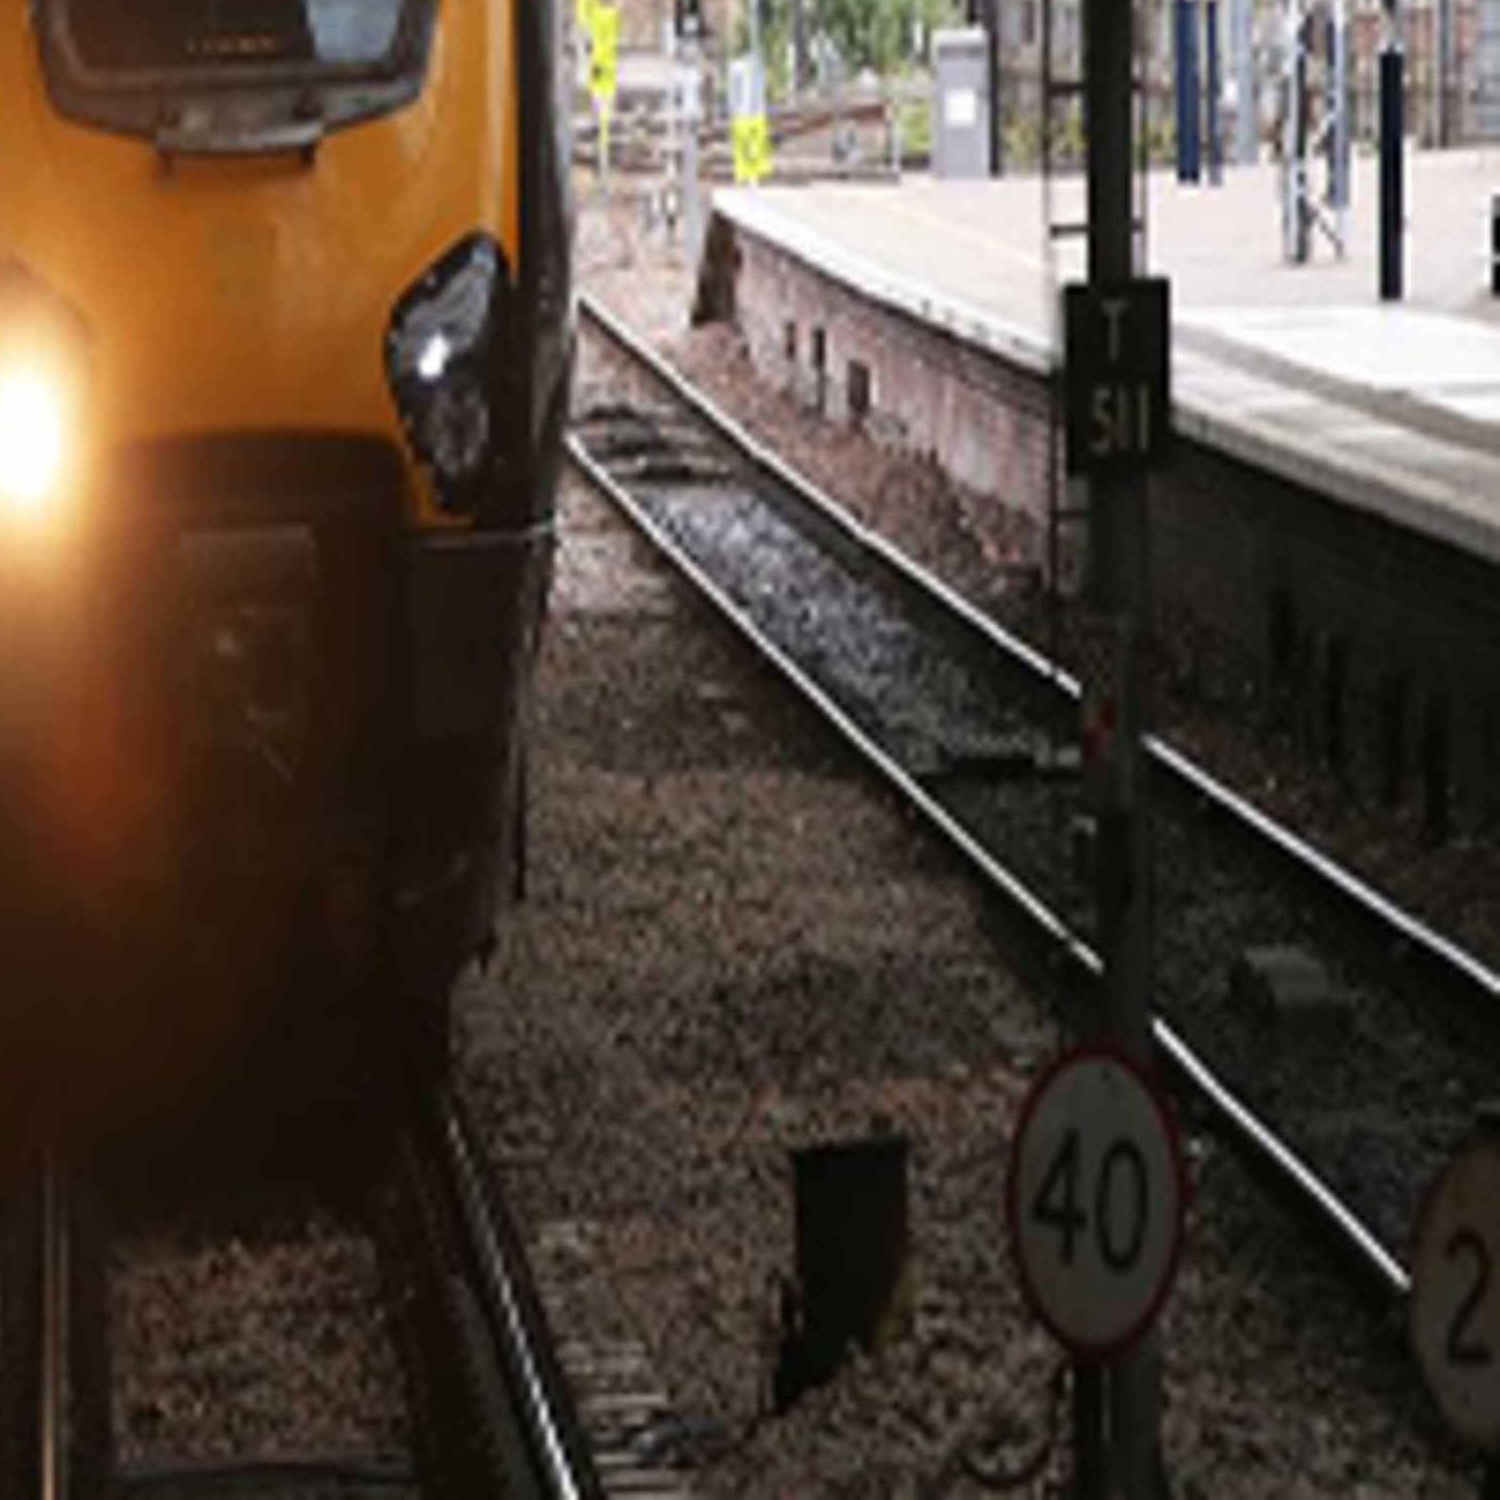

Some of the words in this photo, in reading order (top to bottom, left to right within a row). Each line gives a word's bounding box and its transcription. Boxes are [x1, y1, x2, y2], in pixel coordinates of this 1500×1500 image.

[1100, 299, 1129, 362] T
[1032, 1130, 1148, 1274] 40
[1445, 1225, 1493, 1366] 2
